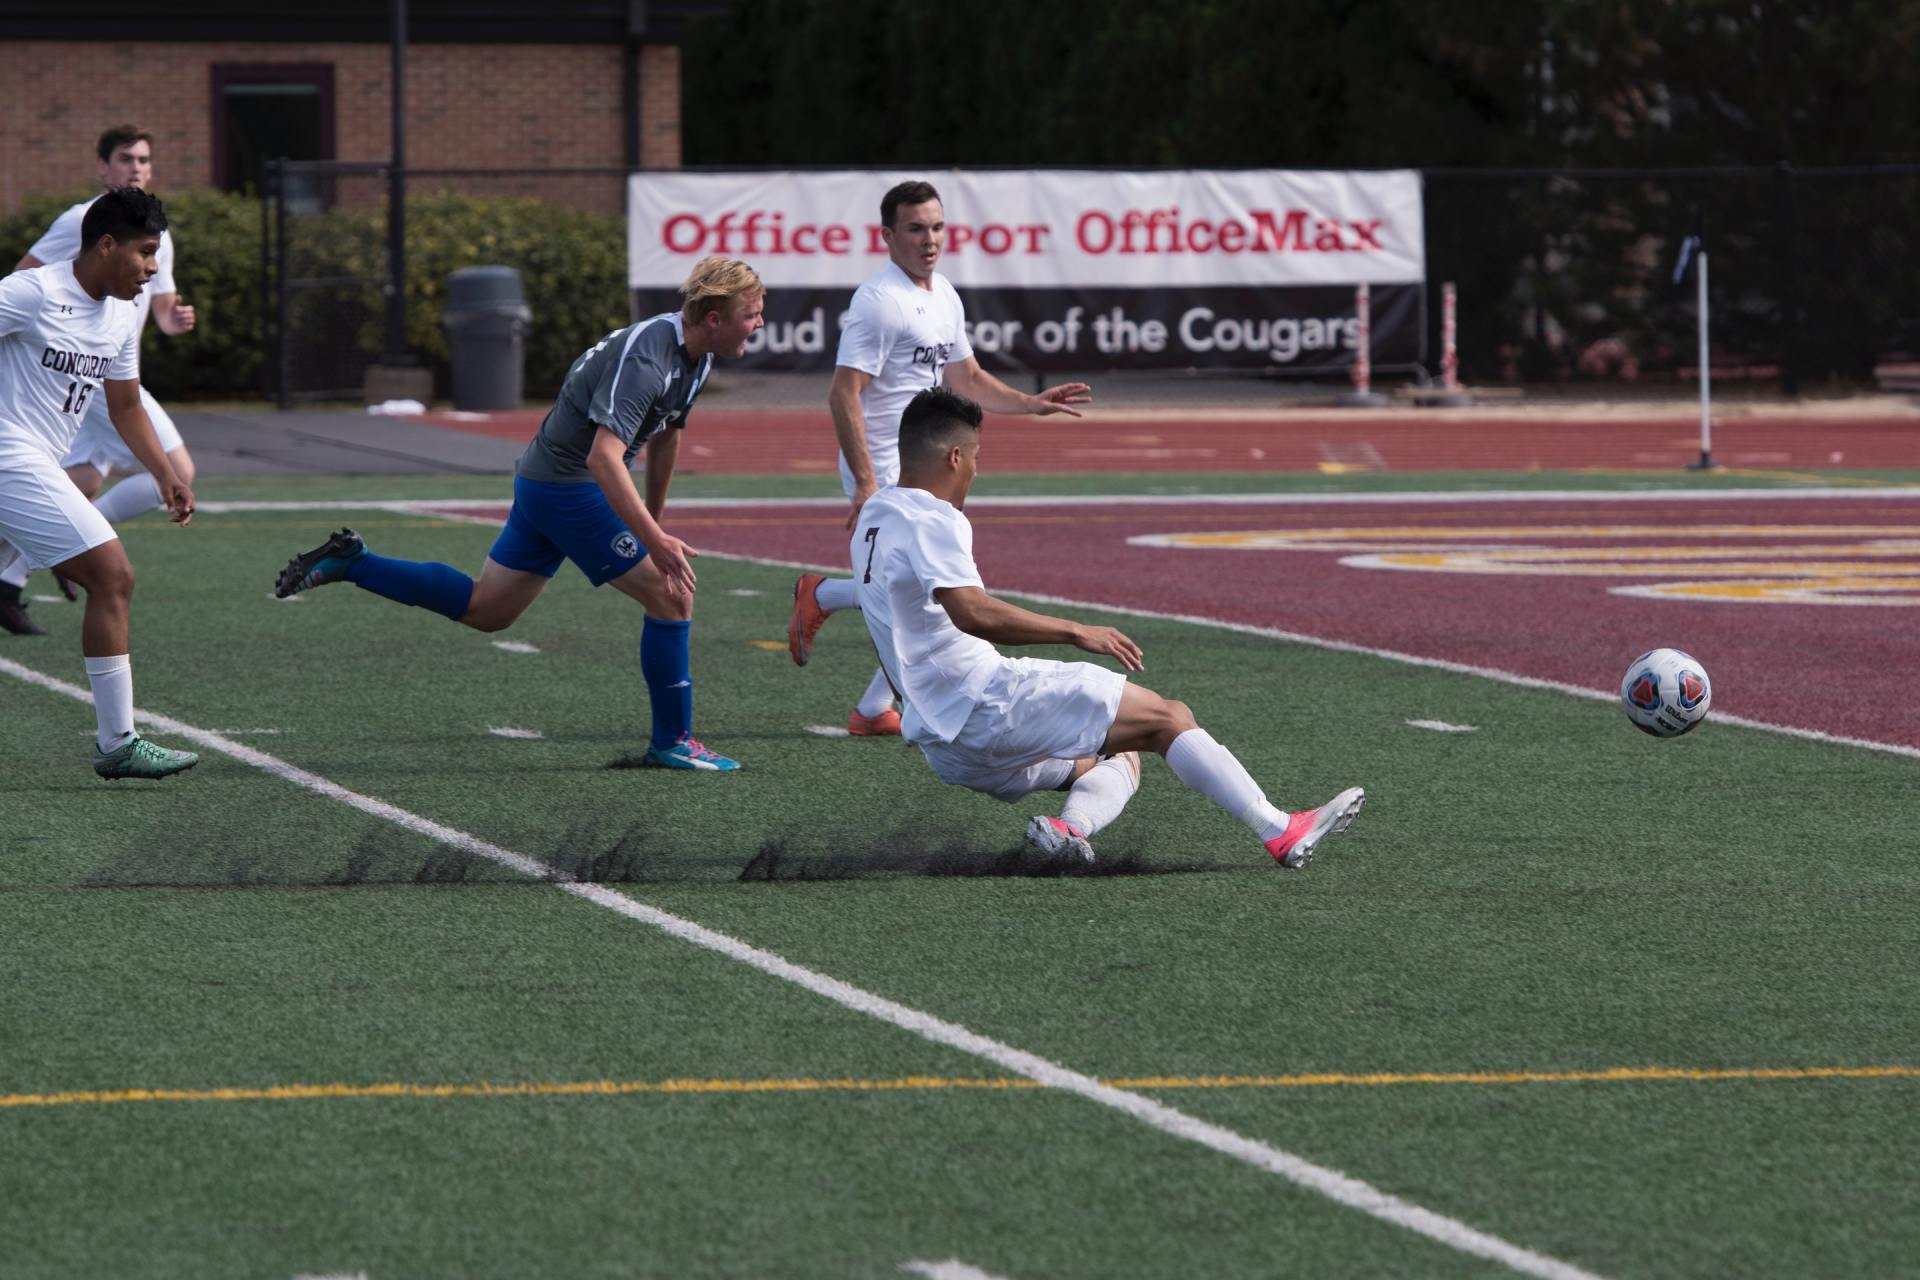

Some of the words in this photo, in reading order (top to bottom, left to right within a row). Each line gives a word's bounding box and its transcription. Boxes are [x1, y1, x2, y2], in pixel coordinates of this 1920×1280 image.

[662, 210, 850, 255] Office
[865, 223, 1051, 255] DPOT
[1076, 206, 1385, 255] OfficeMax
[744, 306, 825, 353] oud
[1034, 306, 1084, 353] of
[1093, 306, 1168, 353] the
[1179, 307, 1362, 362] Cougars
[62, 381, 94, 415] 16
[863, 526, 881, 585] 7
